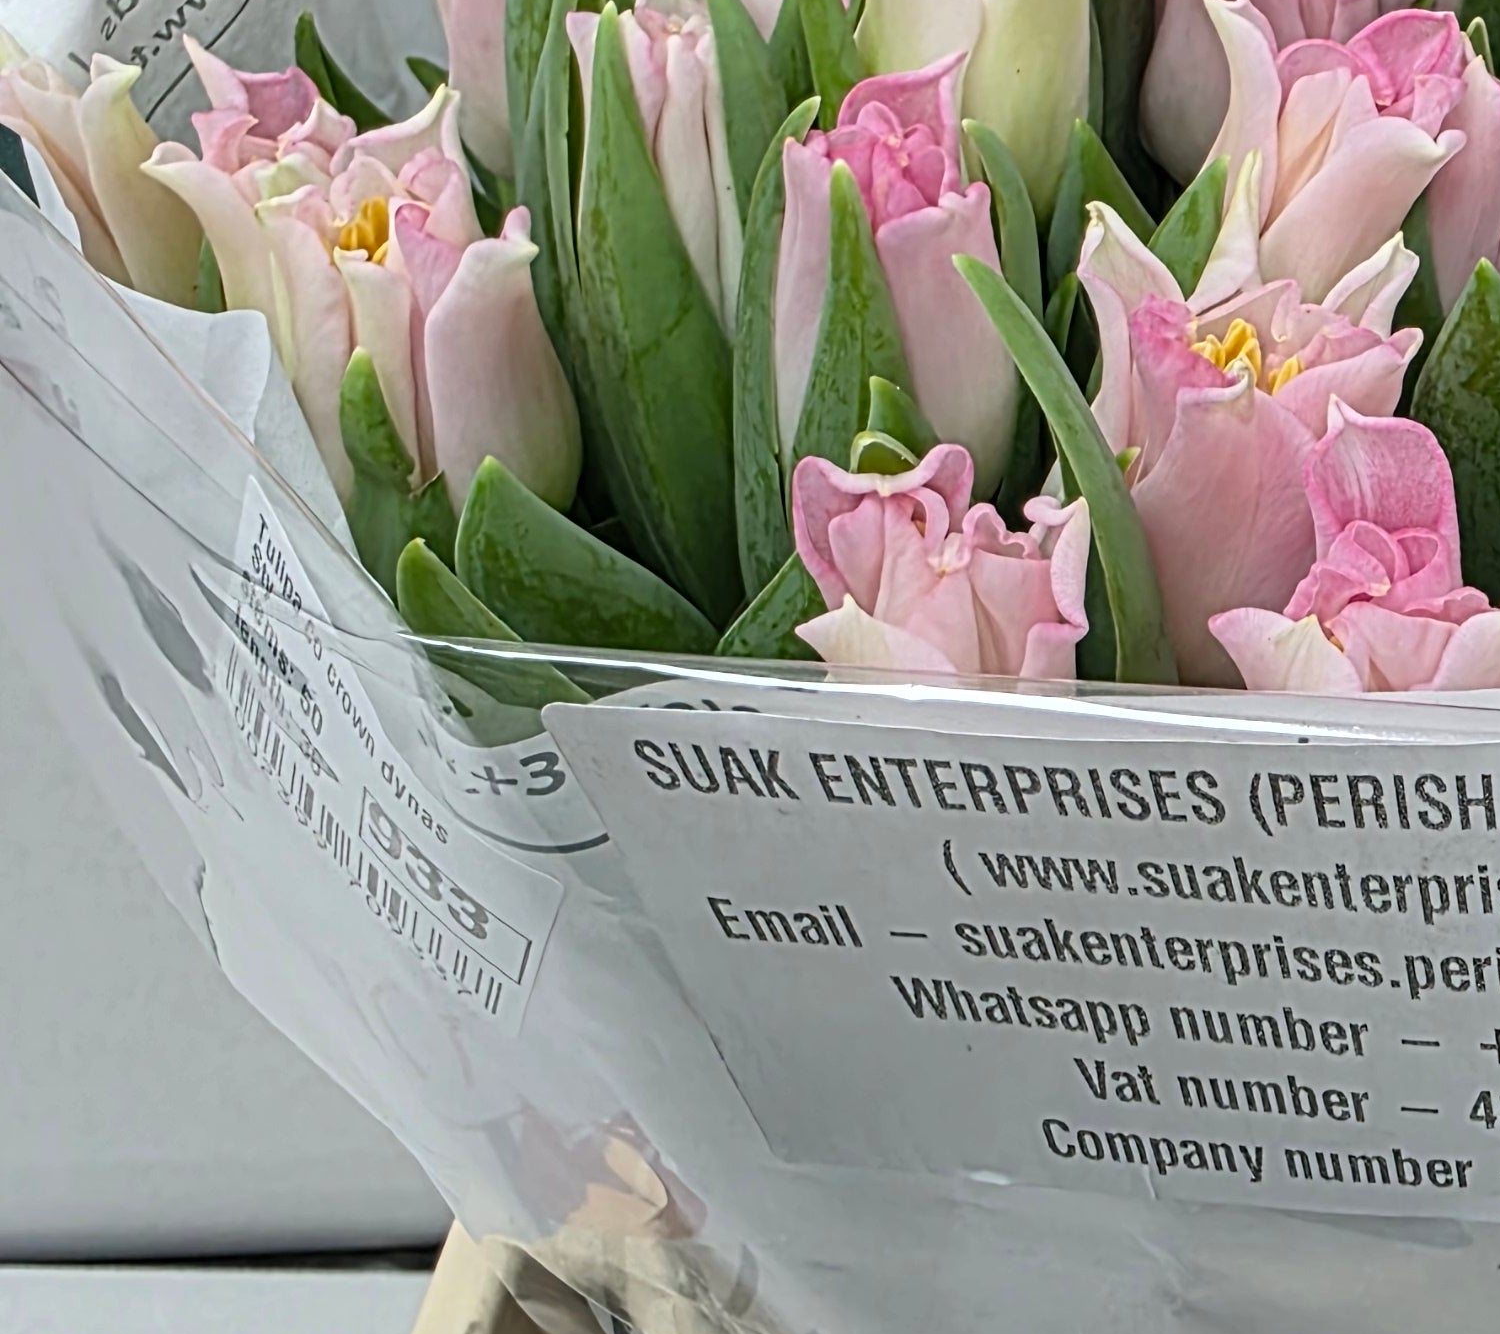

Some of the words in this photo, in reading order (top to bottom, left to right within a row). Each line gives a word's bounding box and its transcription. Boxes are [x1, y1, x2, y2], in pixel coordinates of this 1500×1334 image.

[327, 662, 376, 760] crown
[380, 761, 449, 846] dynas
[633, 739, 800, 801] SUAK
[809, 752, 1226, 826] ENTERPRISES
[366, 801, 489, 941] 933
[707, 896, 863, 948] Email
[891, 975, 1151, 1046] Whatsapp
[1171, 1007, 1369, 1058] number
[1074, 1057, 1159, 1106] Vat
[1177, 1071, 1369, 1124] number
[1042, 1119, 1265, 1184] Company
[1285, 1148, 1474, 1191] number
